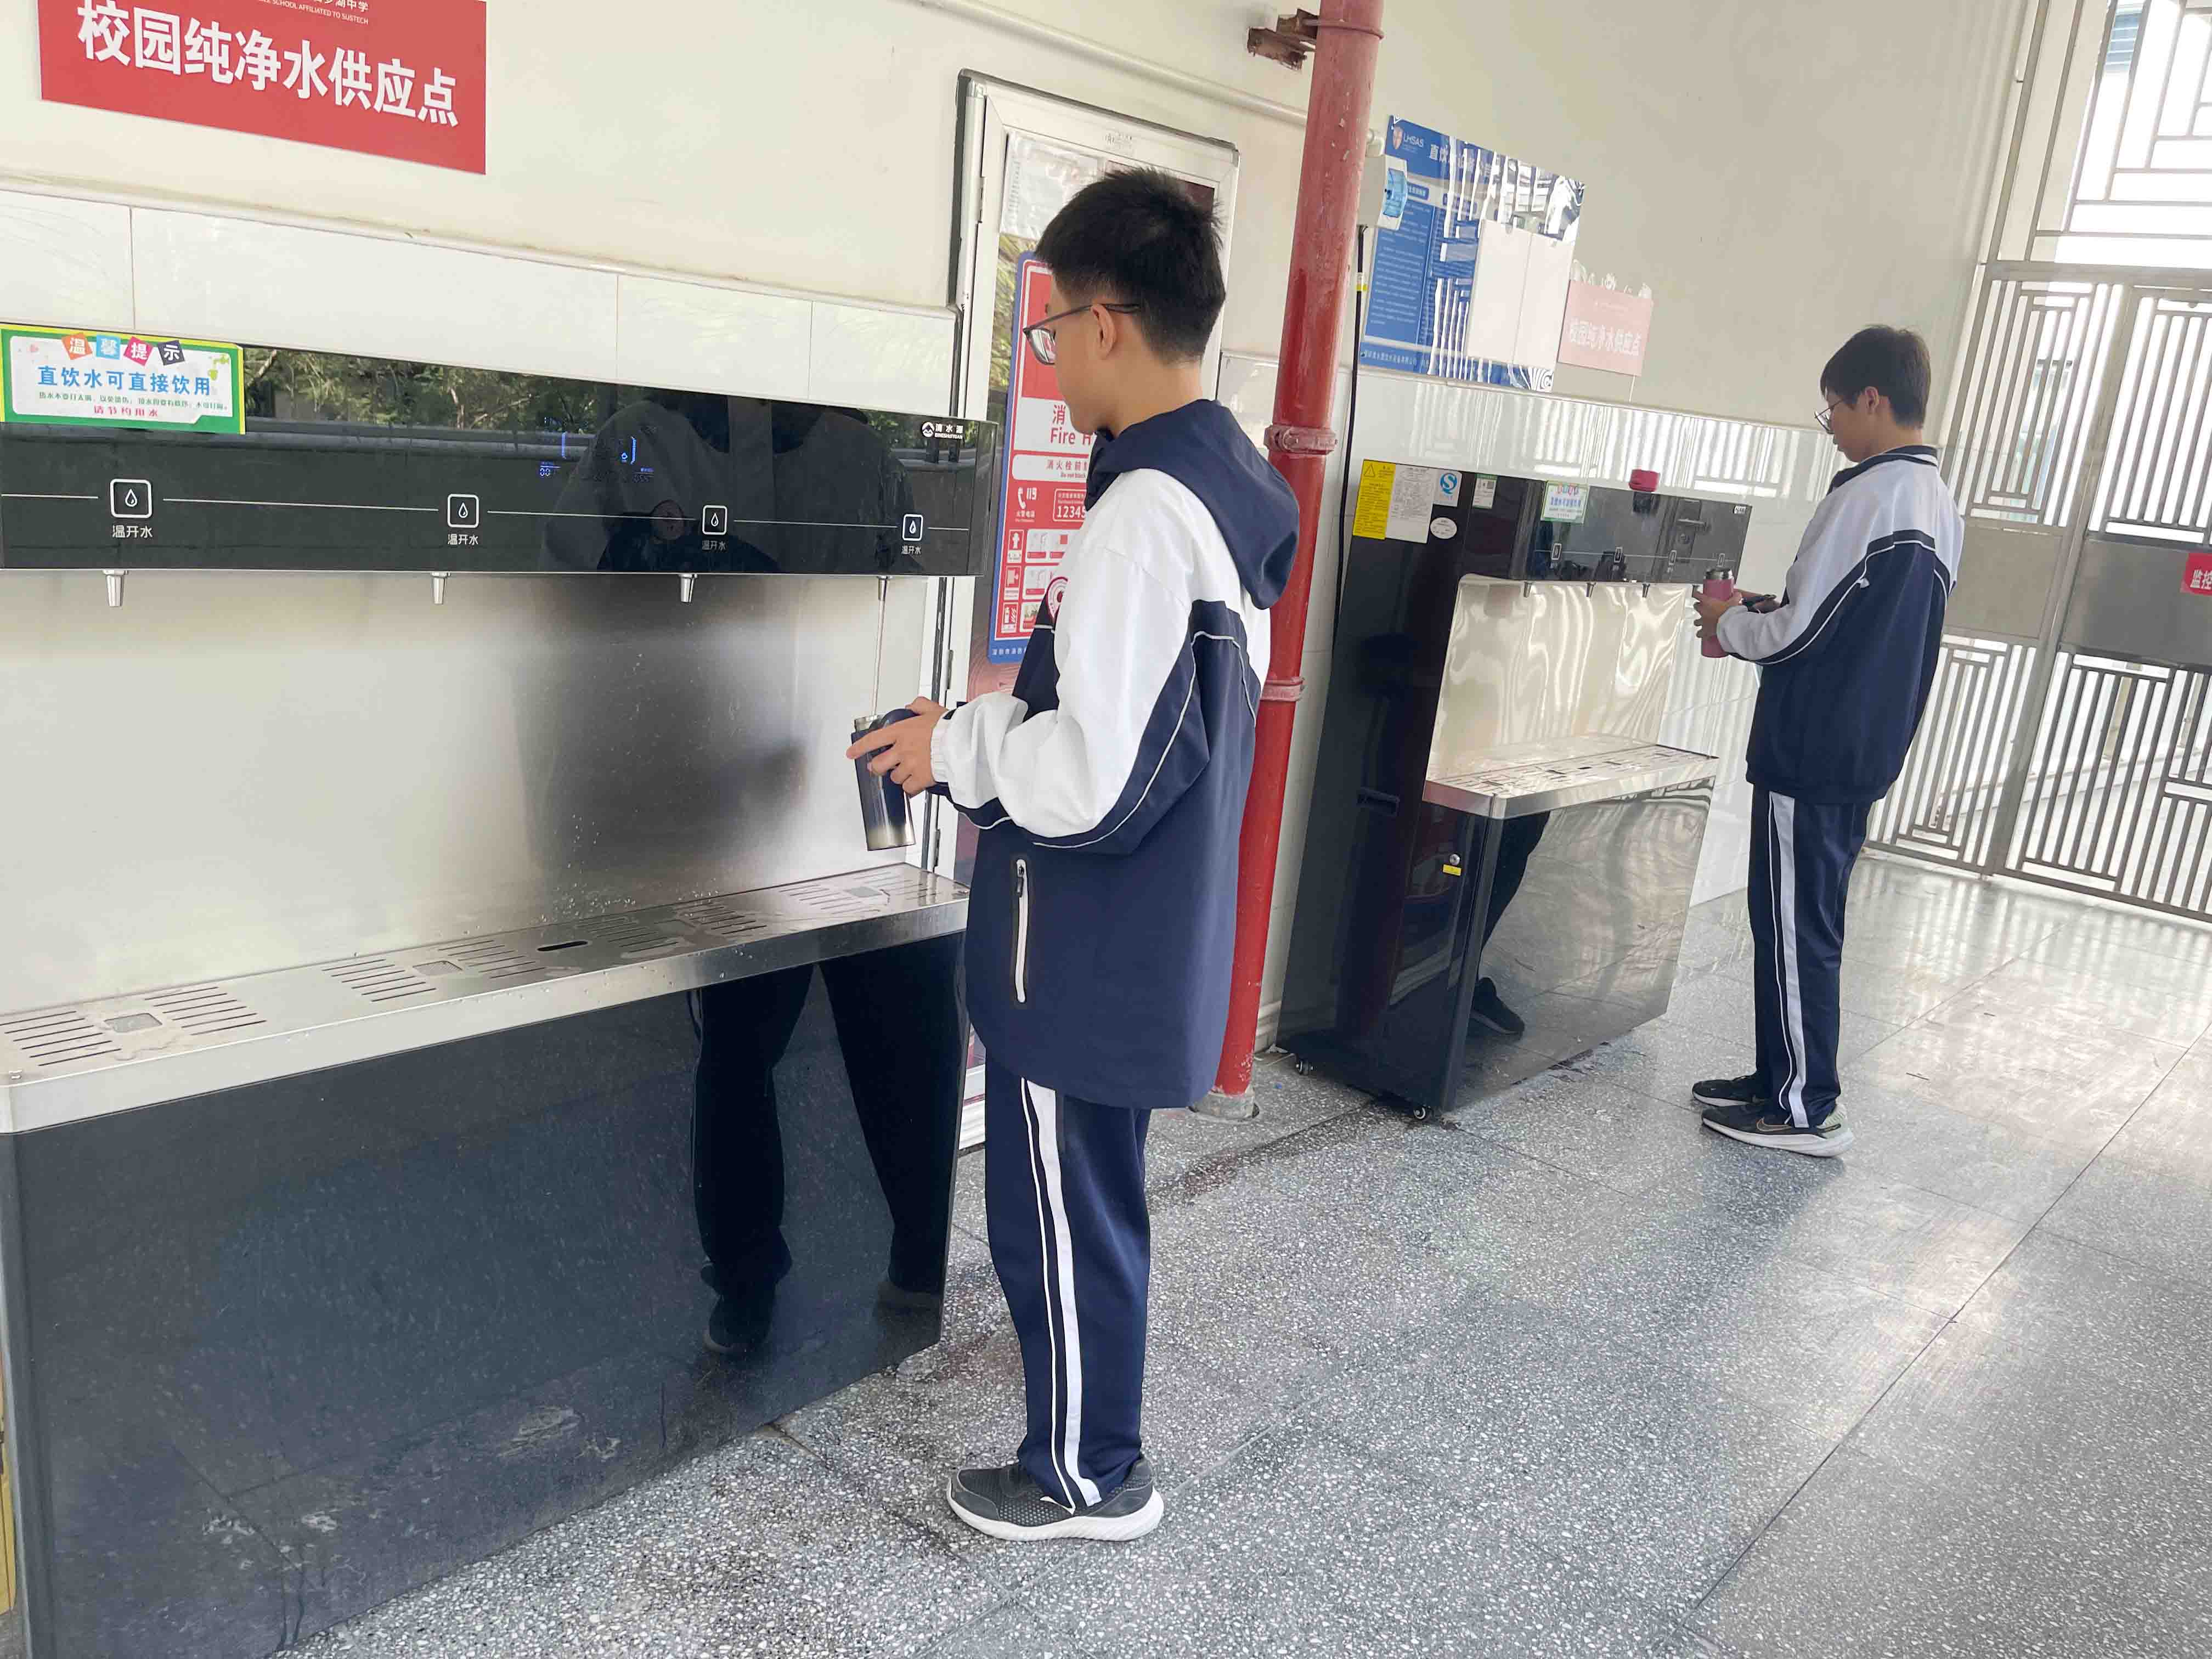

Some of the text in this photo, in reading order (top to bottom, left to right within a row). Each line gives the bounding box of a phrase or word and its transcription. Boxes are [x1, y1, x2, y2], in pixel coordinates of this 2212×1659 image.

[298, 4, 331, 17] AFFILIATED
[342, 13, 369, 25] SUSTECH
[77, 0, 459, 127] 校园纯净水供应点
[37, 365, 211, 396] 直饮水可直接饮用
[1050, 427, 1076, 444] Fire
[112, 525, 153, 539] 温开水
[447, 533, 479, 546] 温开水
[702, 539, 727, 551] 温开水
[901, 544, 922, 555] 温开水
